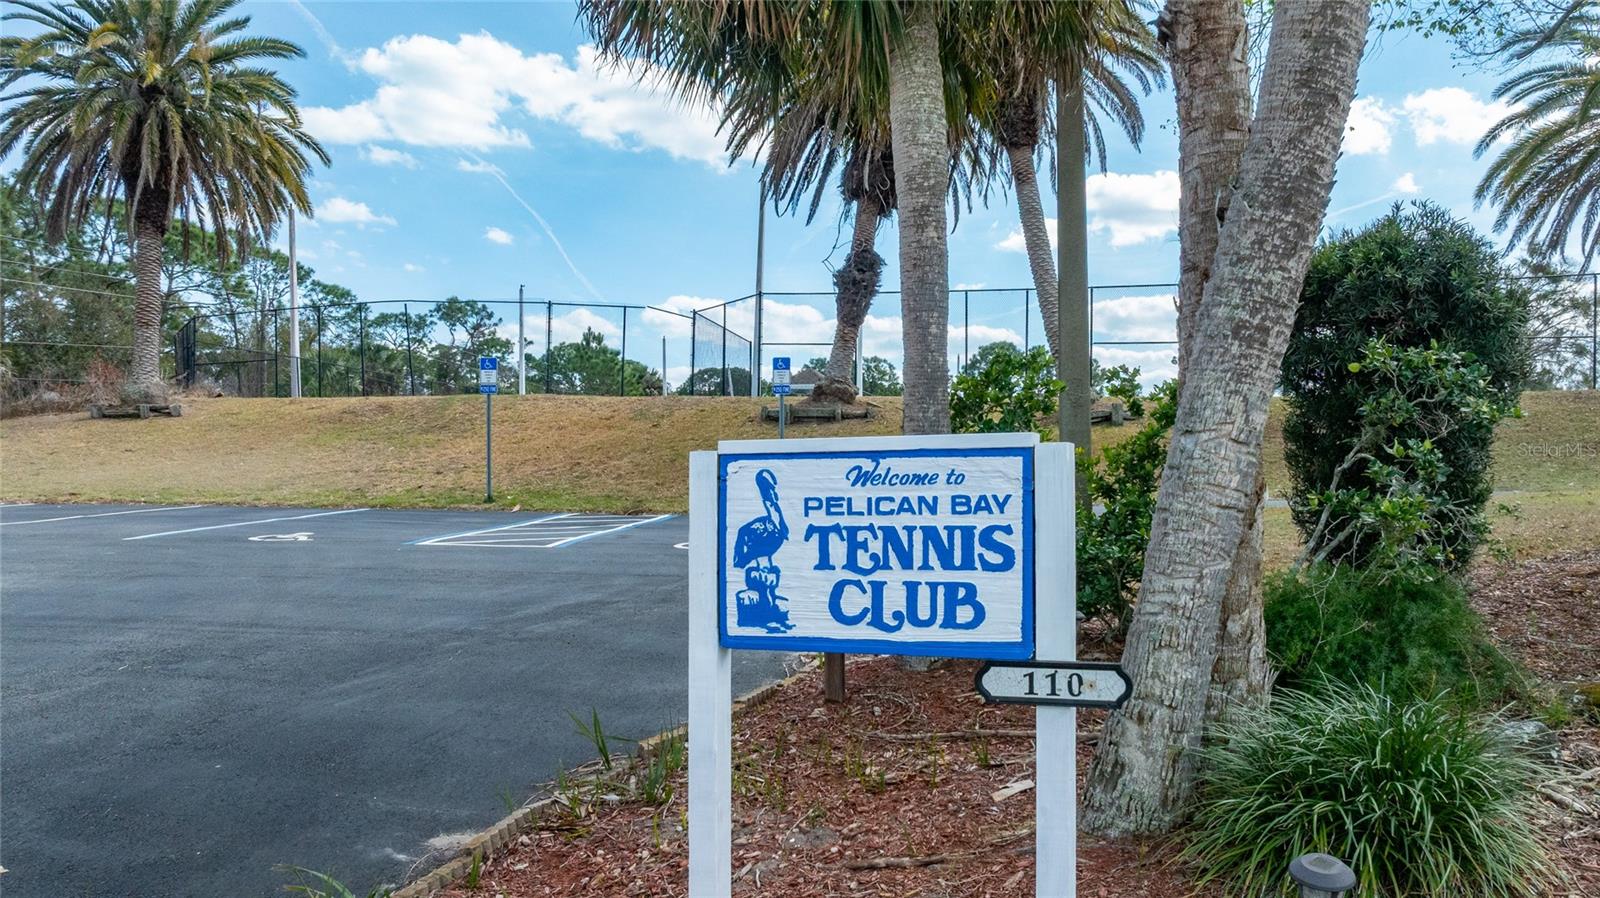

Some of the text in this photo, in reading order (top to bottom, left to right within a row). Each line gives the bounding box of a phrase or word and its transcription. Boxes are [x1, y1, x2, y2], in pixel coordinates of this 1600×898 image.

[846, 459, 966, 487] Welcome to
[803, 494, 1013, 517] PELICAN BAY
[804, 522, 1016, 576] TENNIS
[828, 579, 986, 633] CLUB
[1023, 670, 1084, 697] 110
